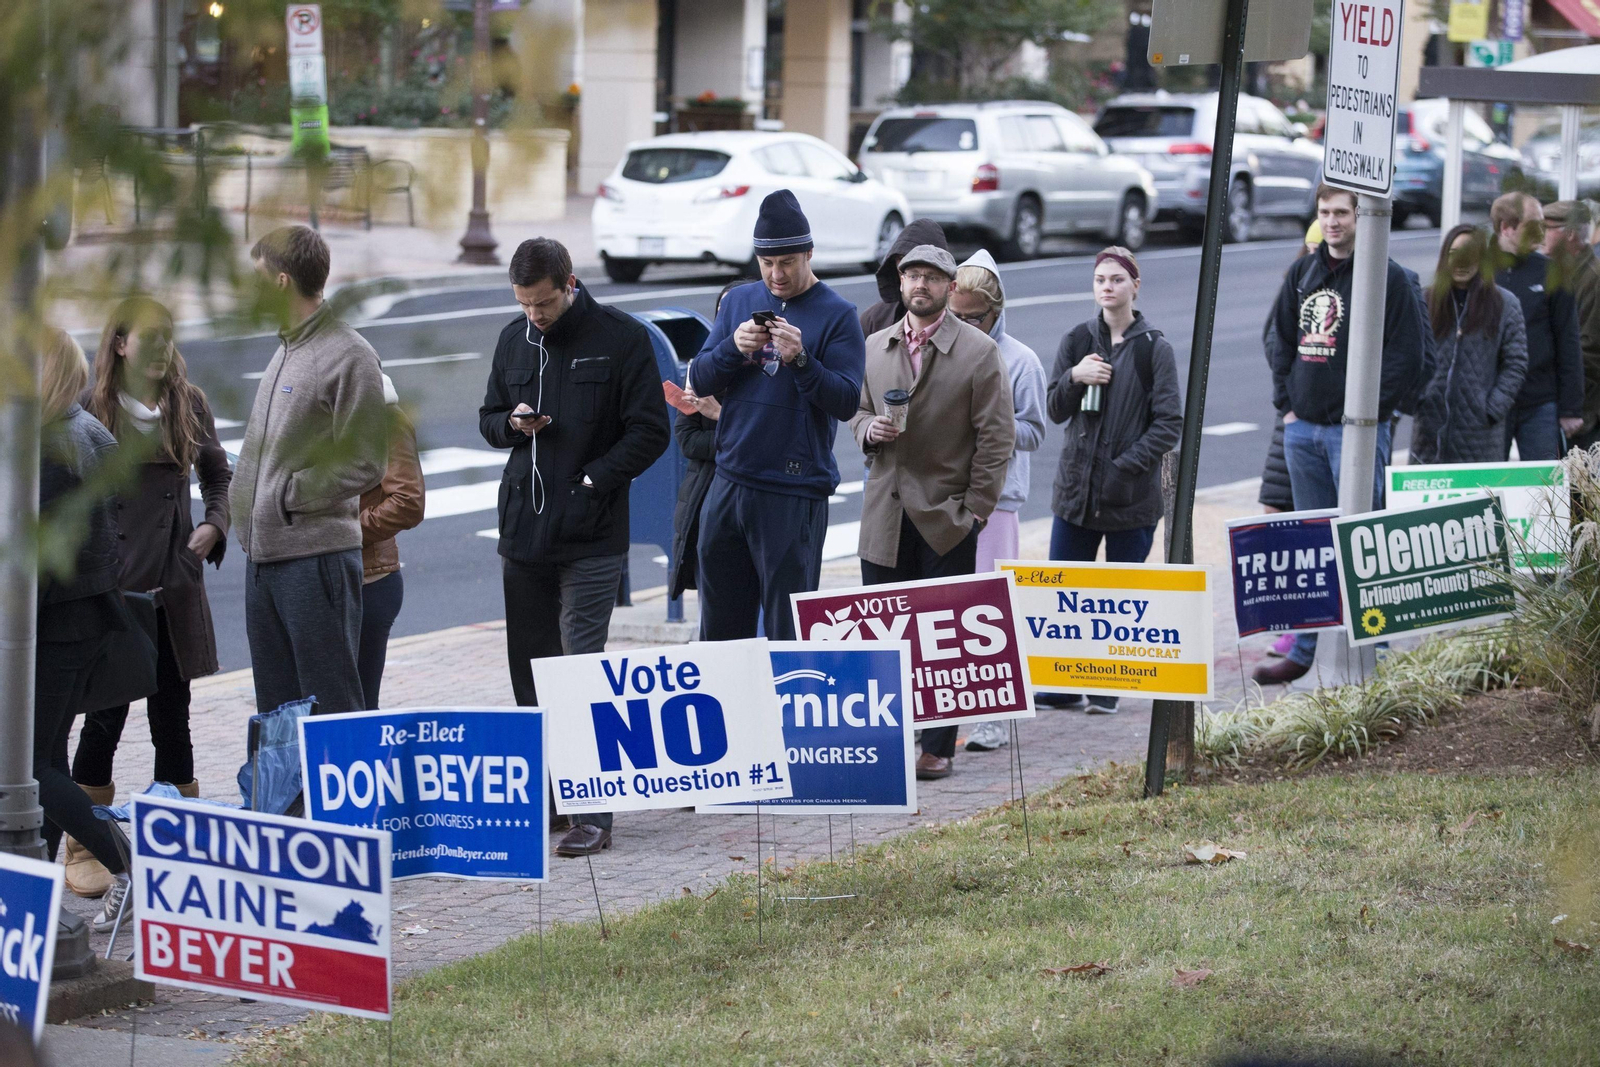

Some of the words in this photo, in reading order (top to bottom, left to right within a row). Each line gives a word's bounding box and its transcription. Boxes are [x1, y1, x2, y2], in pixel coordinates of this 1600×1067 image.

[1340, 2, 1394, 47] YIELD
[1357, 54, 1369, 80] TO
[1330, 84, 1393, 118] PEDESTRIANS
[1352, 120, 1363, 145] IN
[1329, 147, 1385, 182] CROSSWALK
[1402, 478, 1453, 490] REELECT
[1350, 507, 1499, 580] Clement
[1013, 570, 1067, 584] e-Elect
[1237, 546, 1335, 577] TRUMP
[1245, 572, 1327, 594] PENCE
[1255, 594, 1281, 603] AMERICA
[1282, 591, 1306, 600] GREAT
[1306, 590, 1330, 599] AGAIN!
[1359, 582, 1423, 609] Arlington
[1423, 572, 1469, 597] County
[854, 595, 912, 616] VOTE
[1056, 591, 1149, 623] Nancy
[864, 604, 1008, 662] YES
[1025, 616, 1083, 640] Van
[1090, 618, 1181, 645] Doren
[1269, 623, 1290, 631] 2016
[1107, 644, 1182, 659] DEMOCRAT
[600, 655, 701, 696] Vote
[912, 662, 1013, 689] lington
[1054, 661, 1073, 673] for
[1075, 662, 1117, 675] School
[1120, 664, 1158, 678] Board
[775, 678, 900, 728] rnick
[934, 680, 1017, 713] Bond
[379, 720, 466, 747] Re-Elect
[590, 692, 728, 773] NO
[785, 746, 879, 765] ONGRESS
[318, 757, 405, 811] DON
[413, 754, 530, 804] BEYER
[558, 775, 627, 800] Ballot
[632, 768, 741, 799] Question
[749, 761, 784, 785] #1
[382, 816, 412, 832] FOR
[413, 812, 475, 830] CONGRESS
[142, 808, 371, 888] CLINTON
[390, 843, 508, 863] riendsofDonBeyer.com
[145, 867, 297, 932] KAINE
[147, 923, 297, 990] BEYER
